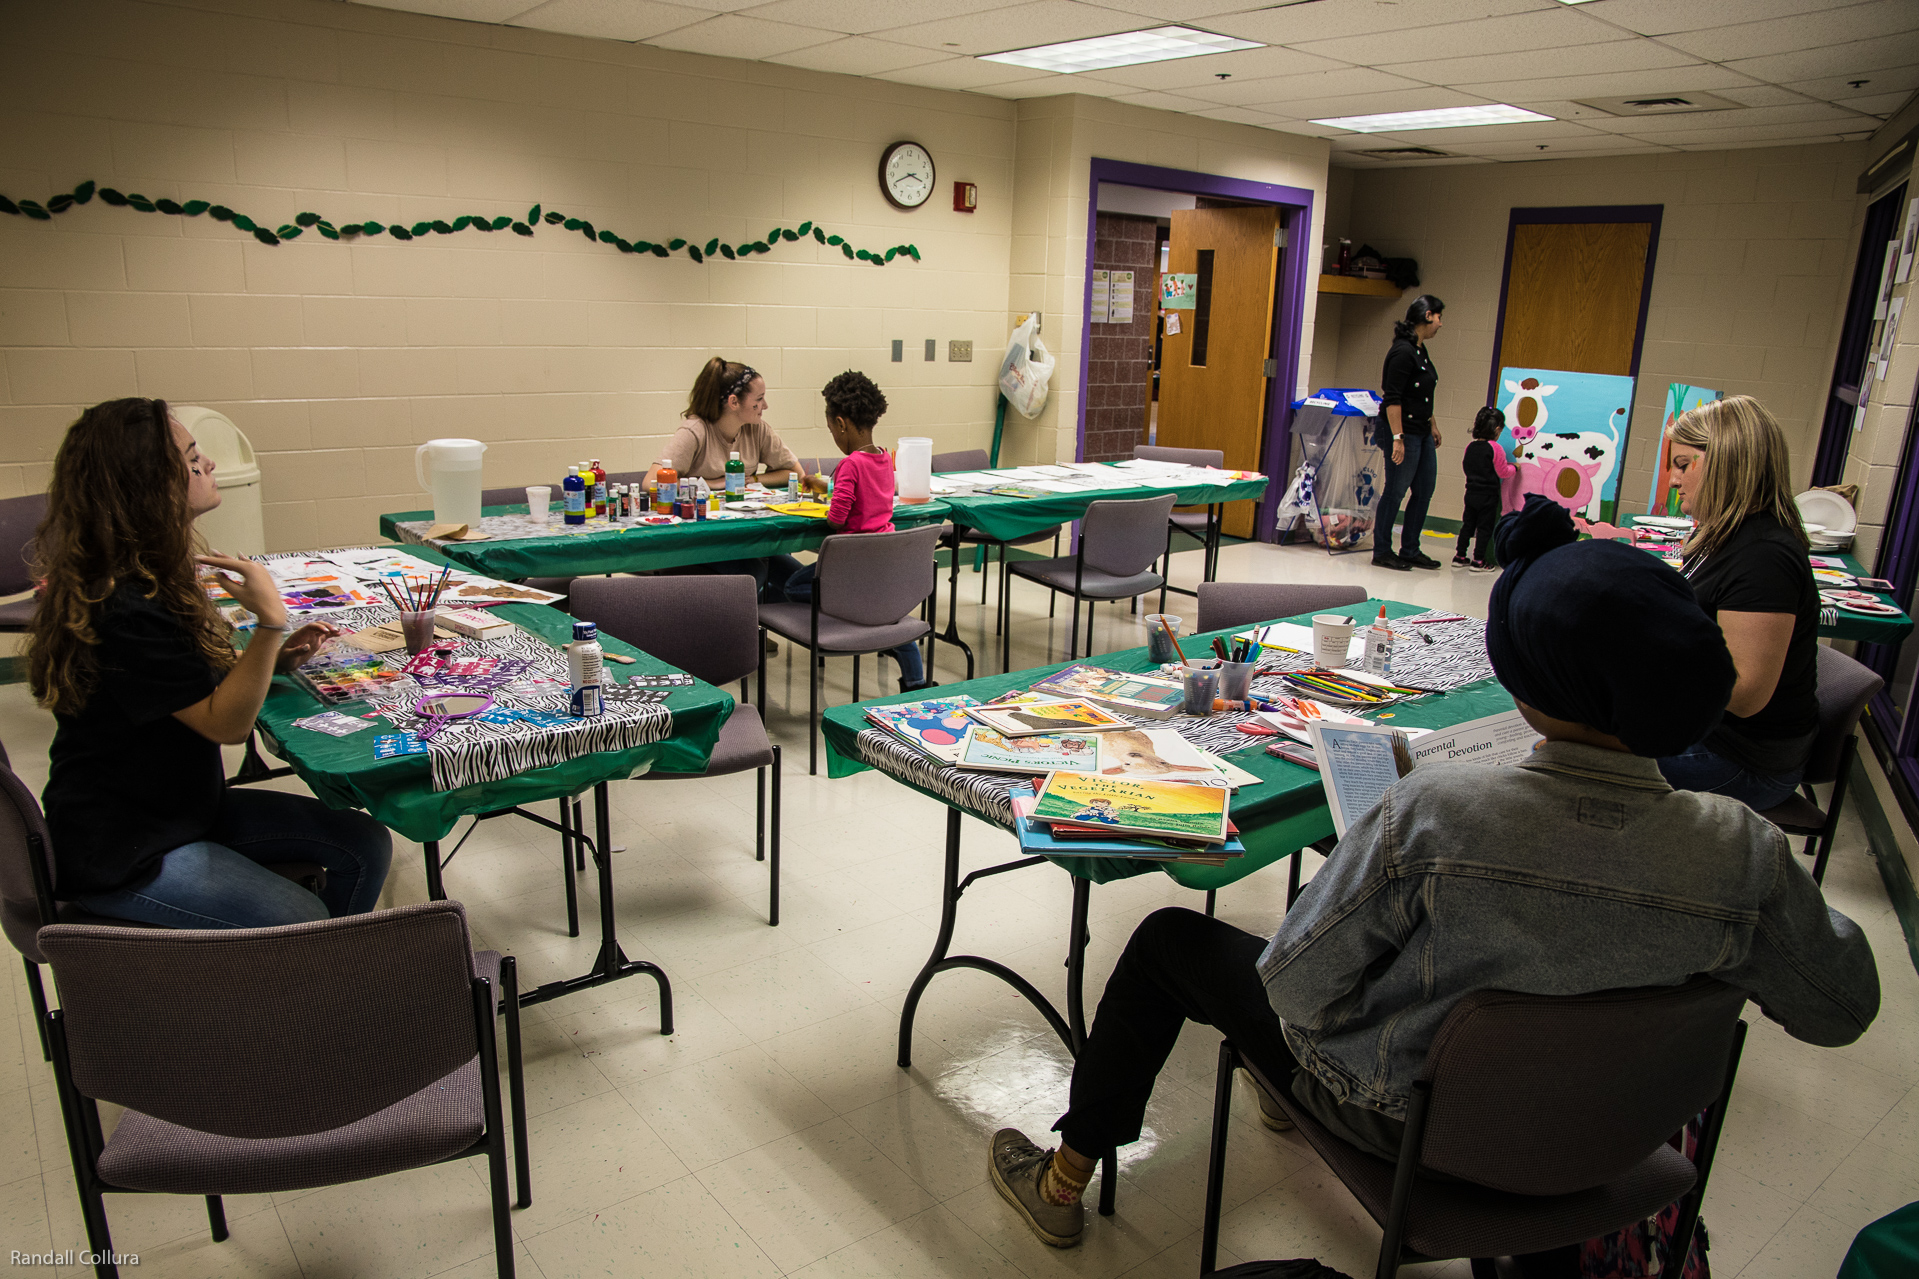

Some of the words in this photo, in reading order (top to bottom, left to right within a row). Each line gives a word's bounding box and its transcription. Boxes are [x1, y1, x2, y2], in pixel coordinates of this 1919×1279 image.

[1415, 739, 1456, 760] Parental
[1448, 741, 1493, 759] Devotion
[981, 753, 1020, 764] PICNIC
[1078, 776, 1144, 790] VICTOR,
[1056, 784, 1156, 800] VEGETARIAN
